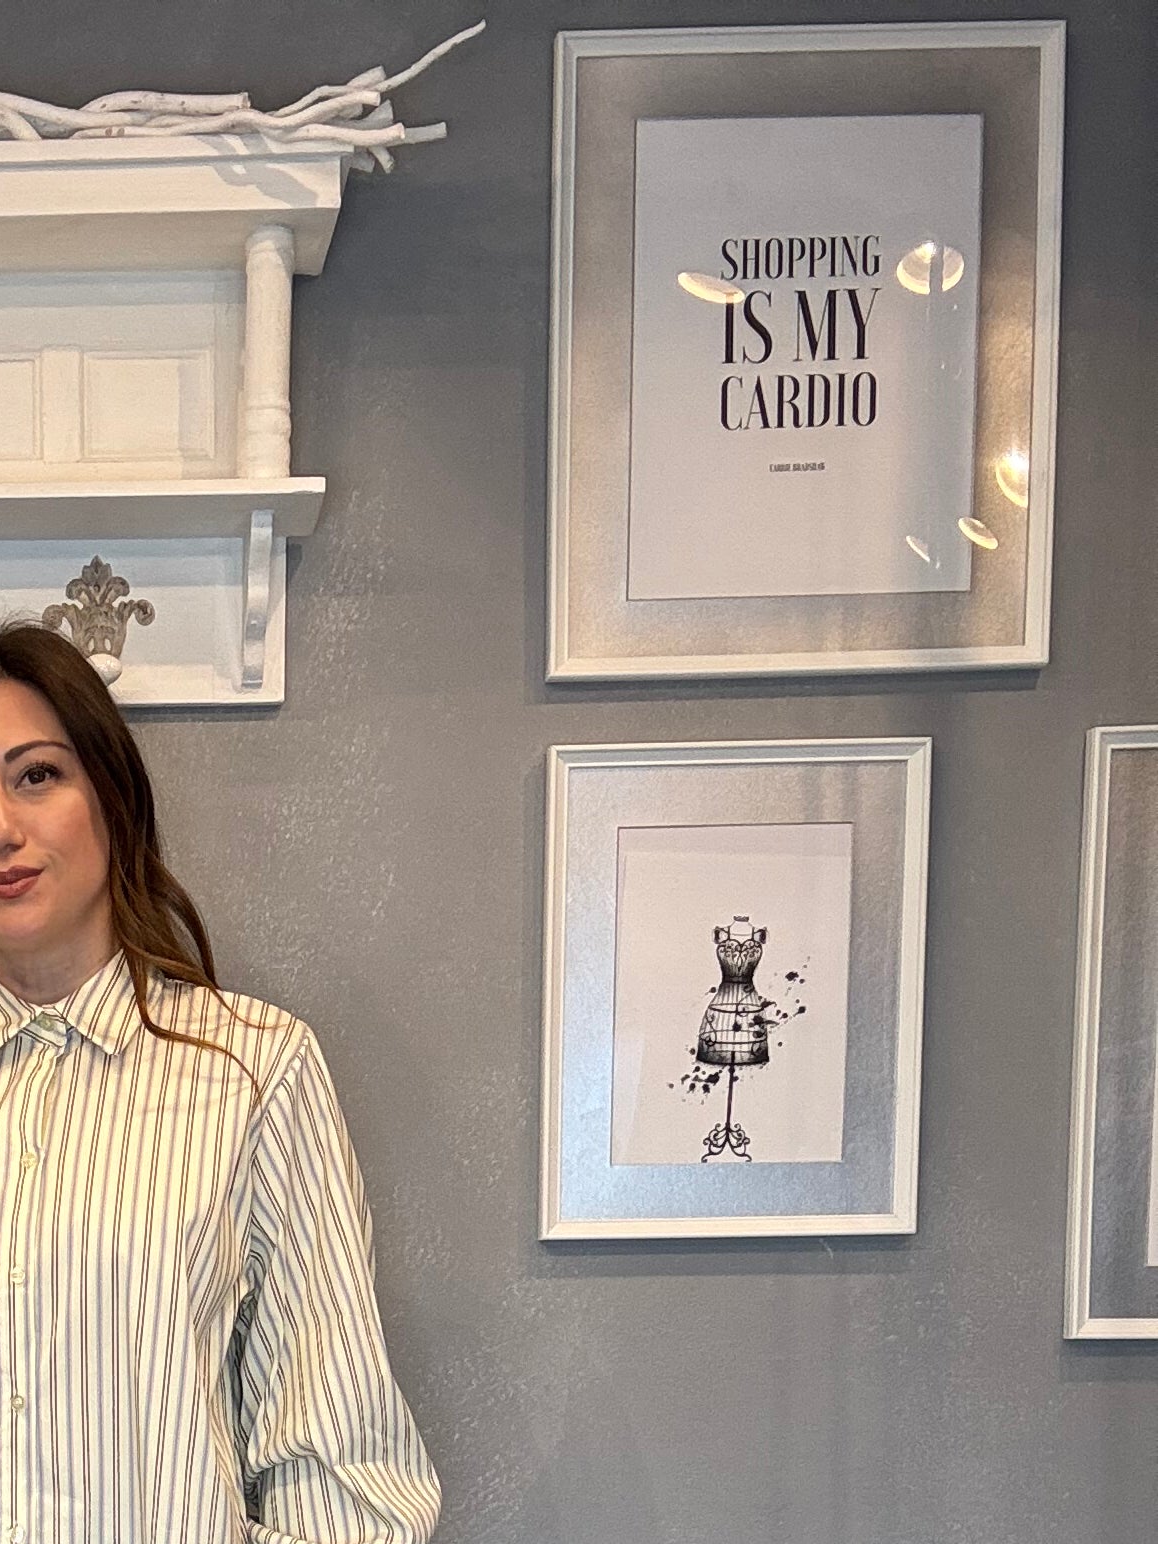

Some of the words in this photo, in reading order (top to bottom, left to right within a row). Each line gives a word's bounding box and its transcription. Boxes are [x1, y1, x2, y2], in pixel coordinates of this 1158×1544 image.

[720, 235, 882, 281] SHOPPING
[721, 289, 773, 364] IS
[792, 287, 883, 362] MY
[720, 371, 878, 430] CARDIO
